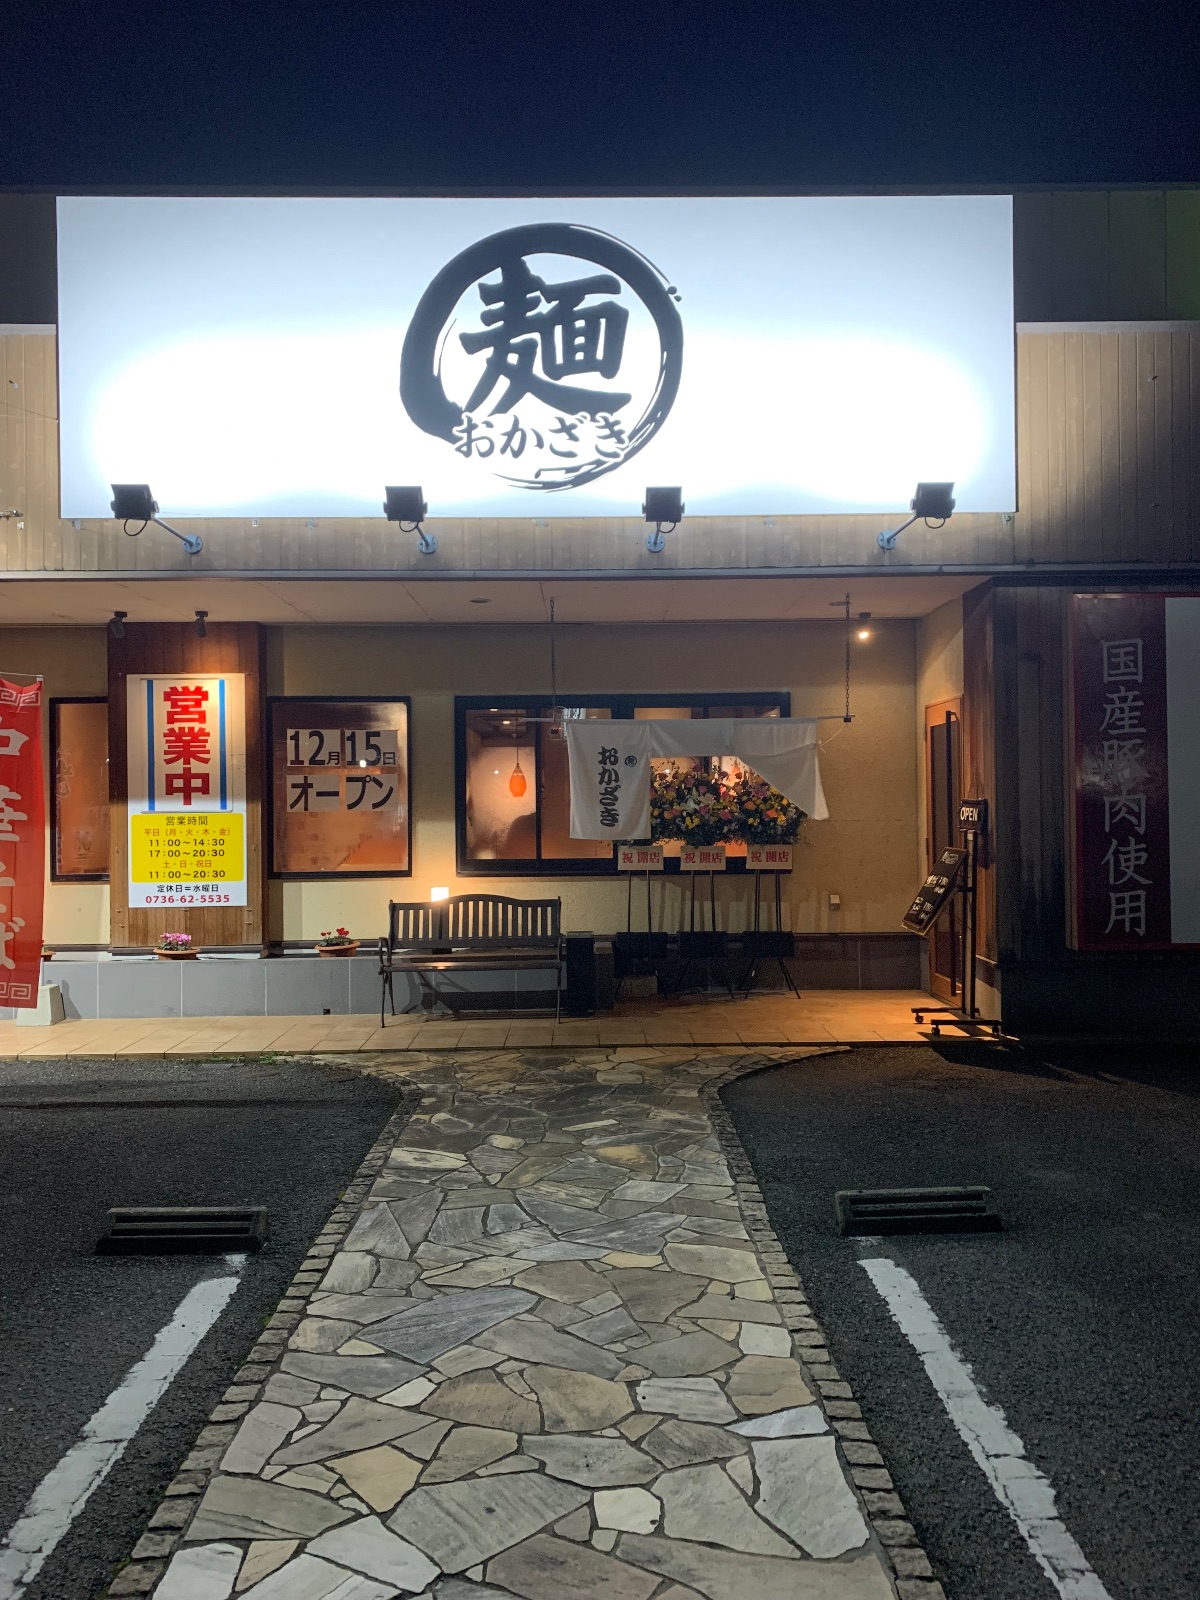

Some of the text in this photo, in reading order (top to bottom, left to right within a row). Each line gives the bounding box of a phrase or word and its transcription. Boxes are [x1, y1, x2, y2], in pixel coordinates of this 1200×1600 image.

[459, 254, 632, 418] 麺
[454, 414, 626, 459] おかざき
[163, 686, 211, 806] 営業中
[289, 774, 394, 812] オープン
[598, 745, 621, 828] おかざき
[1100, 638, 1153, 937] 国産豚肉使用
[165, 815, 209, 826] 営業時間
[960, 806, 979, 821] OPEN
[145, 894, 230, 904] 0736-62-5535
[156, 883, 219, 893] 定休日＝水曜日
